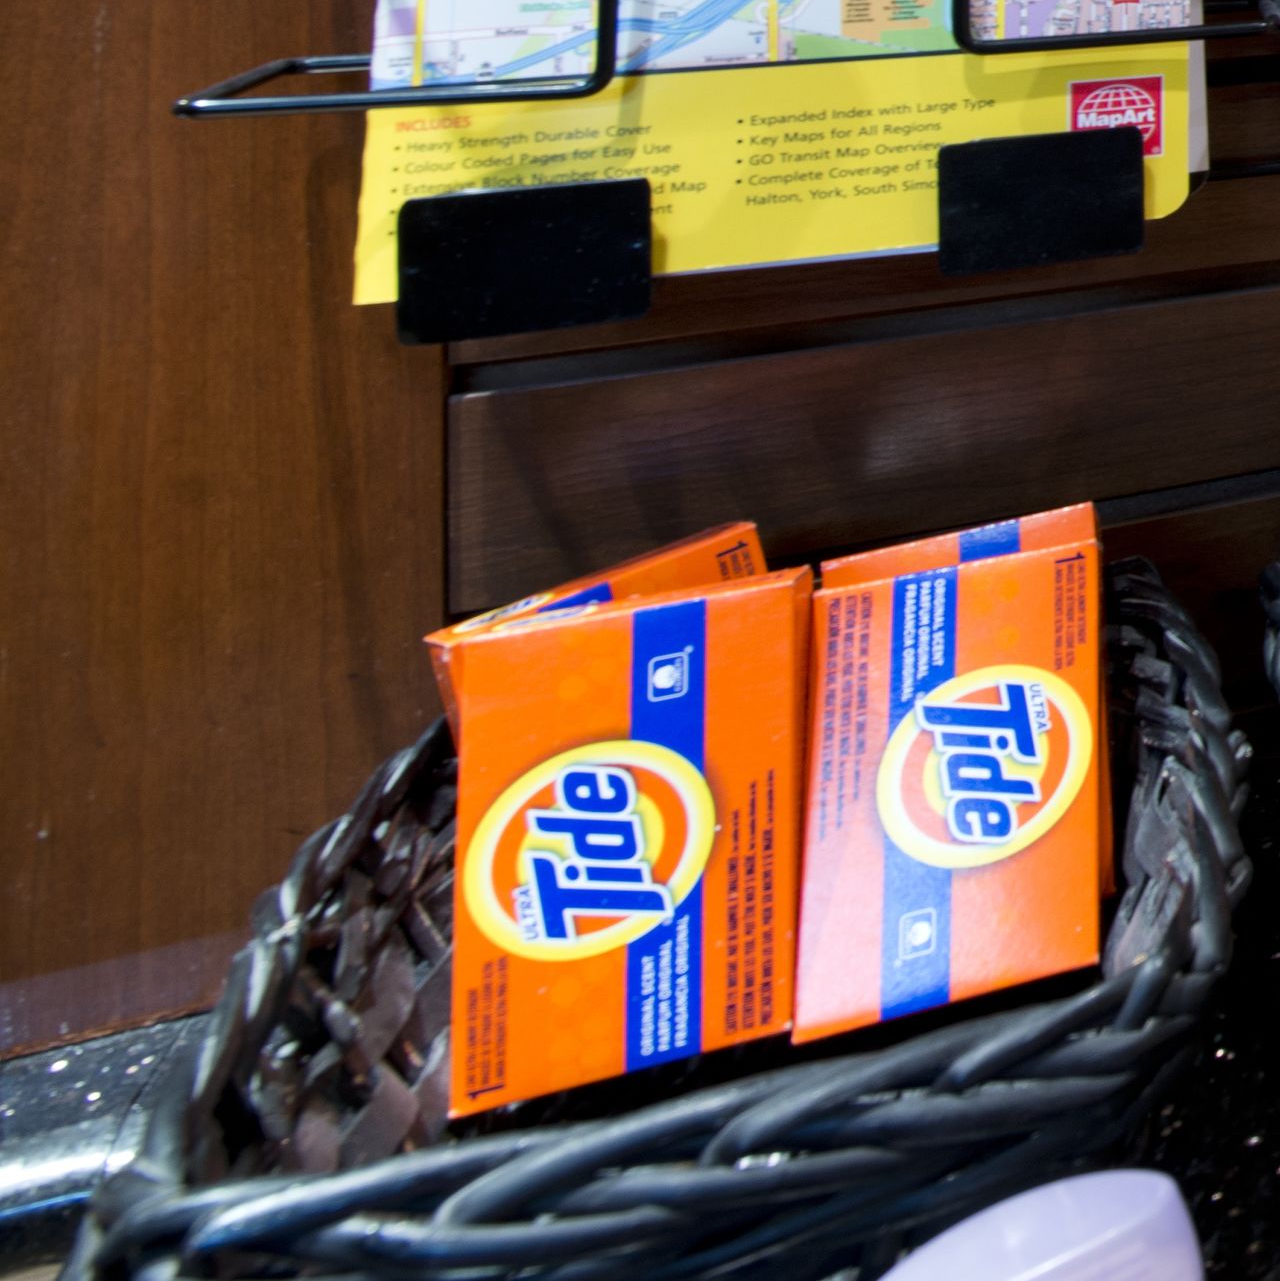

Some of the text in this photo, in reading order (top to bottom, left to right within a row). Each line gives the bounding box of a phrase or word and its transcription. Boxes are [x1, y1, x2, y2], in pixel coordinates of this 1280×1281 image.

[395, 115, 472, 134] INCLUDES
[749, 96, 996, 128] Expanded Index with Large Type
[749, 119, 942, 149] Key Maps for All Regions
[1077, 107, 1156, 130] MapArt
[747, 159, 922, 190] Complete Coverage of
[900, 583, 915, 702] FRAGANCIA ORIGINAL
[917, 581, 931, 680] PARFUM ORIGINAL
[933, 578, 947, 667] ORIGINAL SCENT
[1029, 682, 1048, 732] ULTRA
[919, 681, 1038, 840] Tide
[530, 769, 669, 941] Tide
[517, 885, 540, 942] ULTRA
[640, 955, 656, 1056] ORIGINAL SCENT
